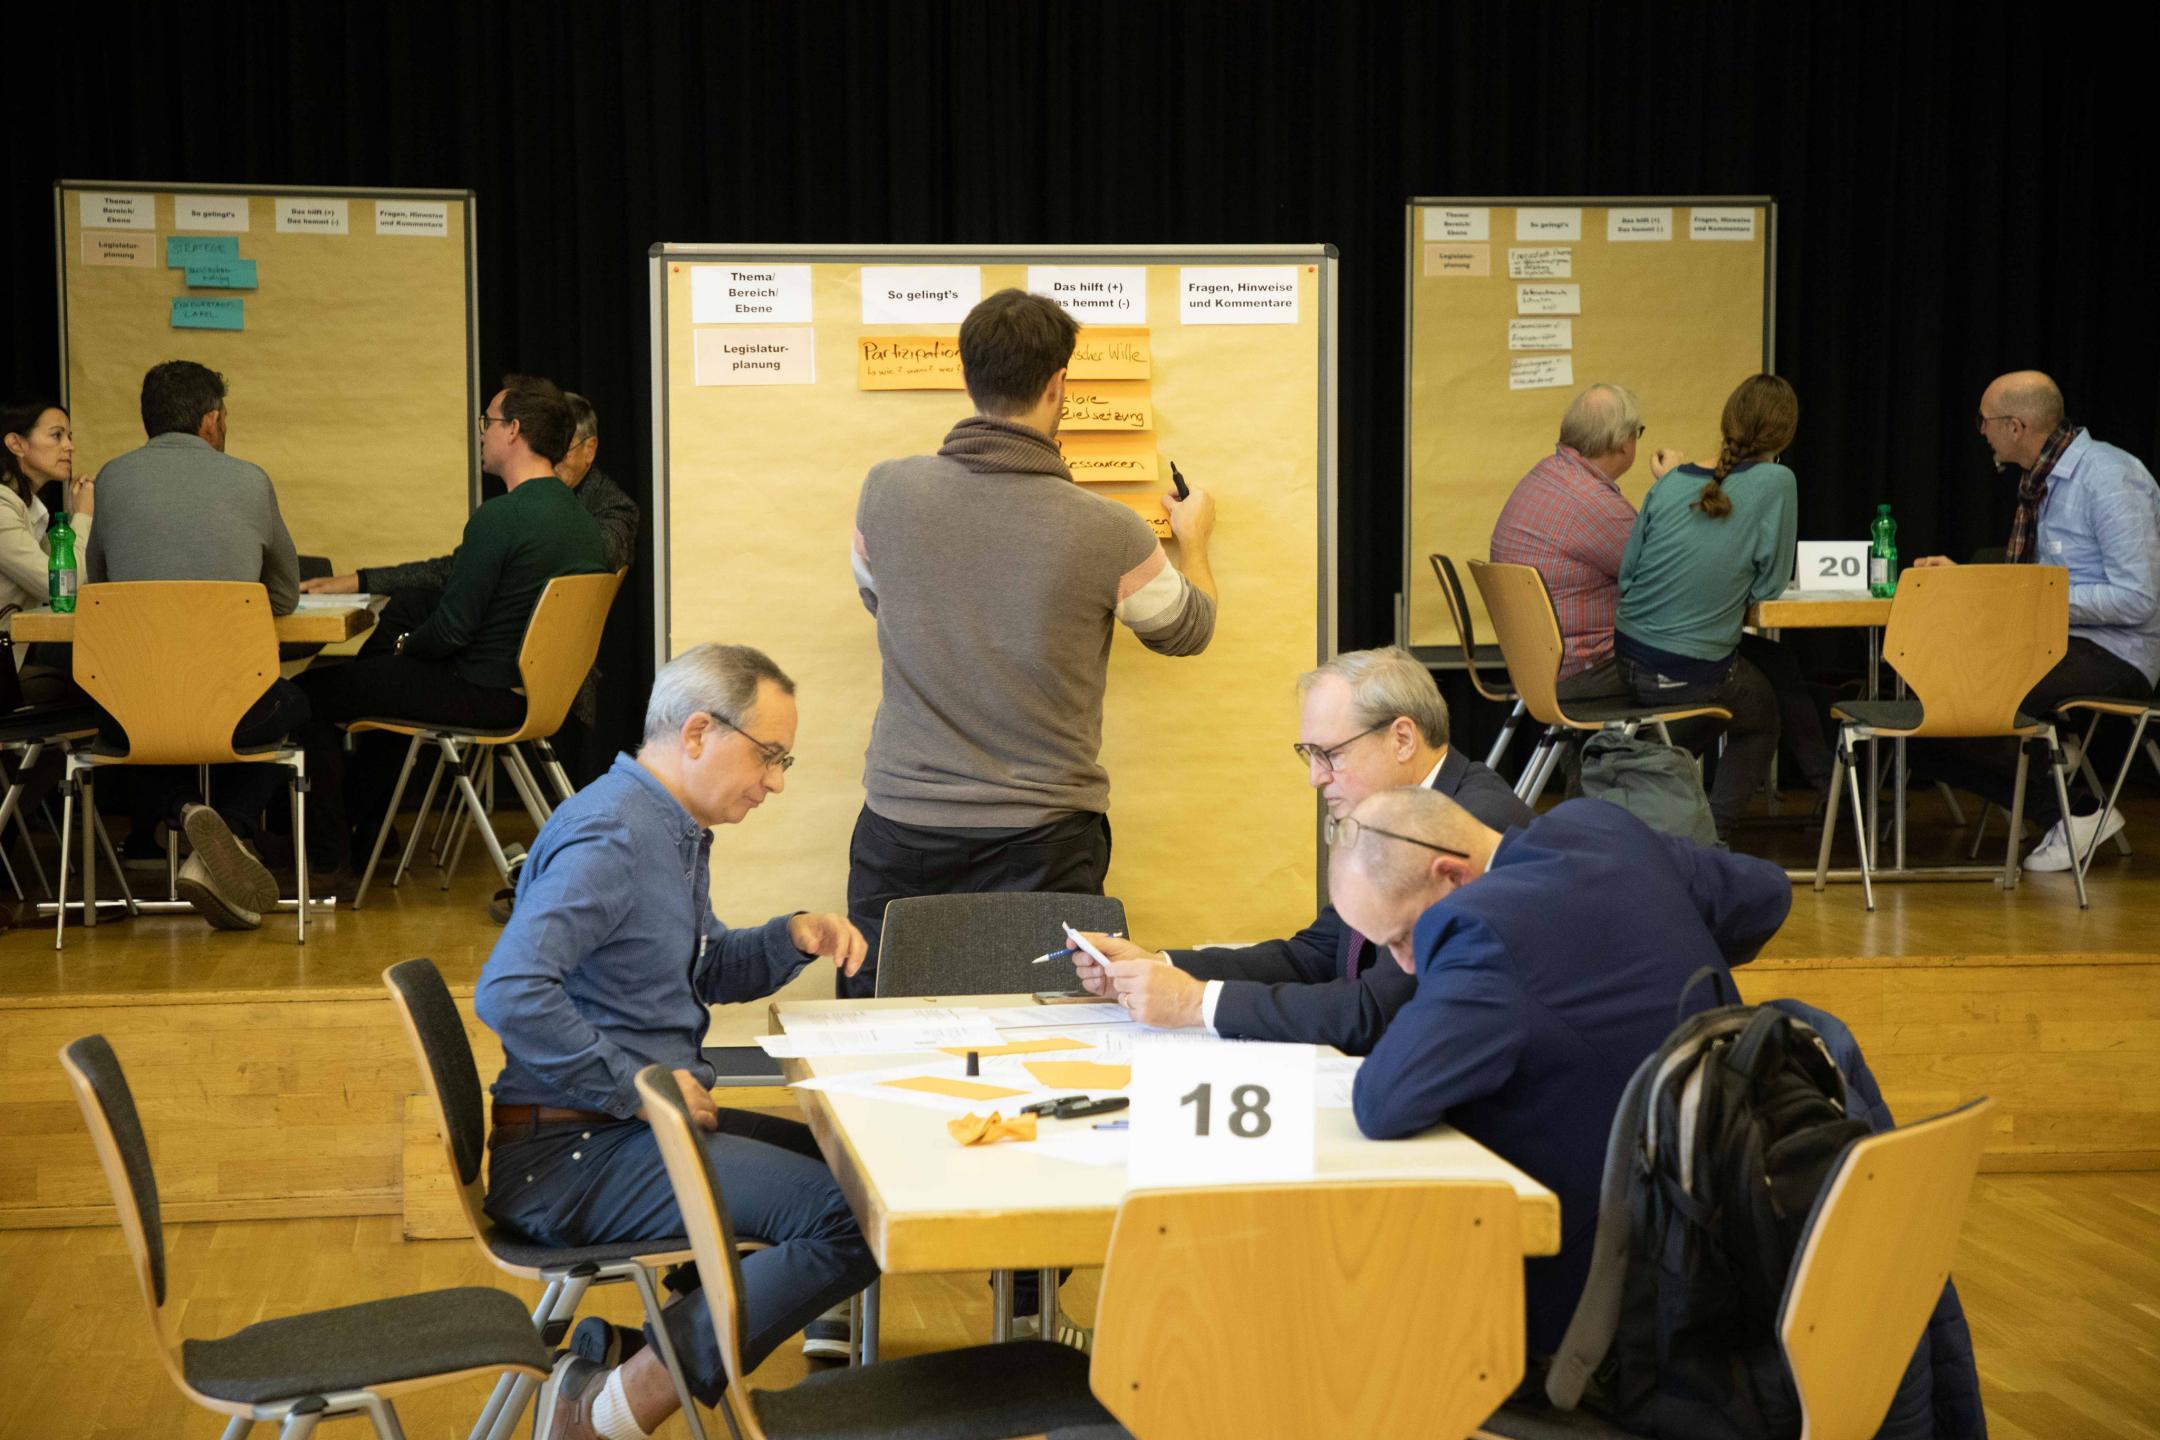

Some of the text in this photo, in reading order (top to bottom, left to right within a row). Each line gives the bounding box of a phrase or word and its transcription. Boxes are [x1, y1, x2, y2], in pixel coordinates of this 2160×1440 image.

[380, 210, 408, 219] Fragen,
[98, 241, 140, 250] Legislatur-
[103, 252, 135, 260] planung
[730, 272, 776, 282] Thema/
[728, 287, 779, 298] Bereich/
[1053, 282, 1124, 294] Das hilft (+)
[1188, 283, 1293, 295] Fragen, Hinweise
[887, 290, 903, 300] So
[735, 304, 773, 314] Ebene
[1072, 298, 1115, 308] hemmt
[1118, 299, 1131, 310] (-)
[1189, 299, 1293, 308] und Kommentare
[723, 343, 789, 356] Legislatur-
[1071, 343, 1147, 363] ischer Wille
[732, 359, 782, 371] planung
[1818, 556, 1861, 577] 20
[1180, 1082, 1272, 1138] 18
